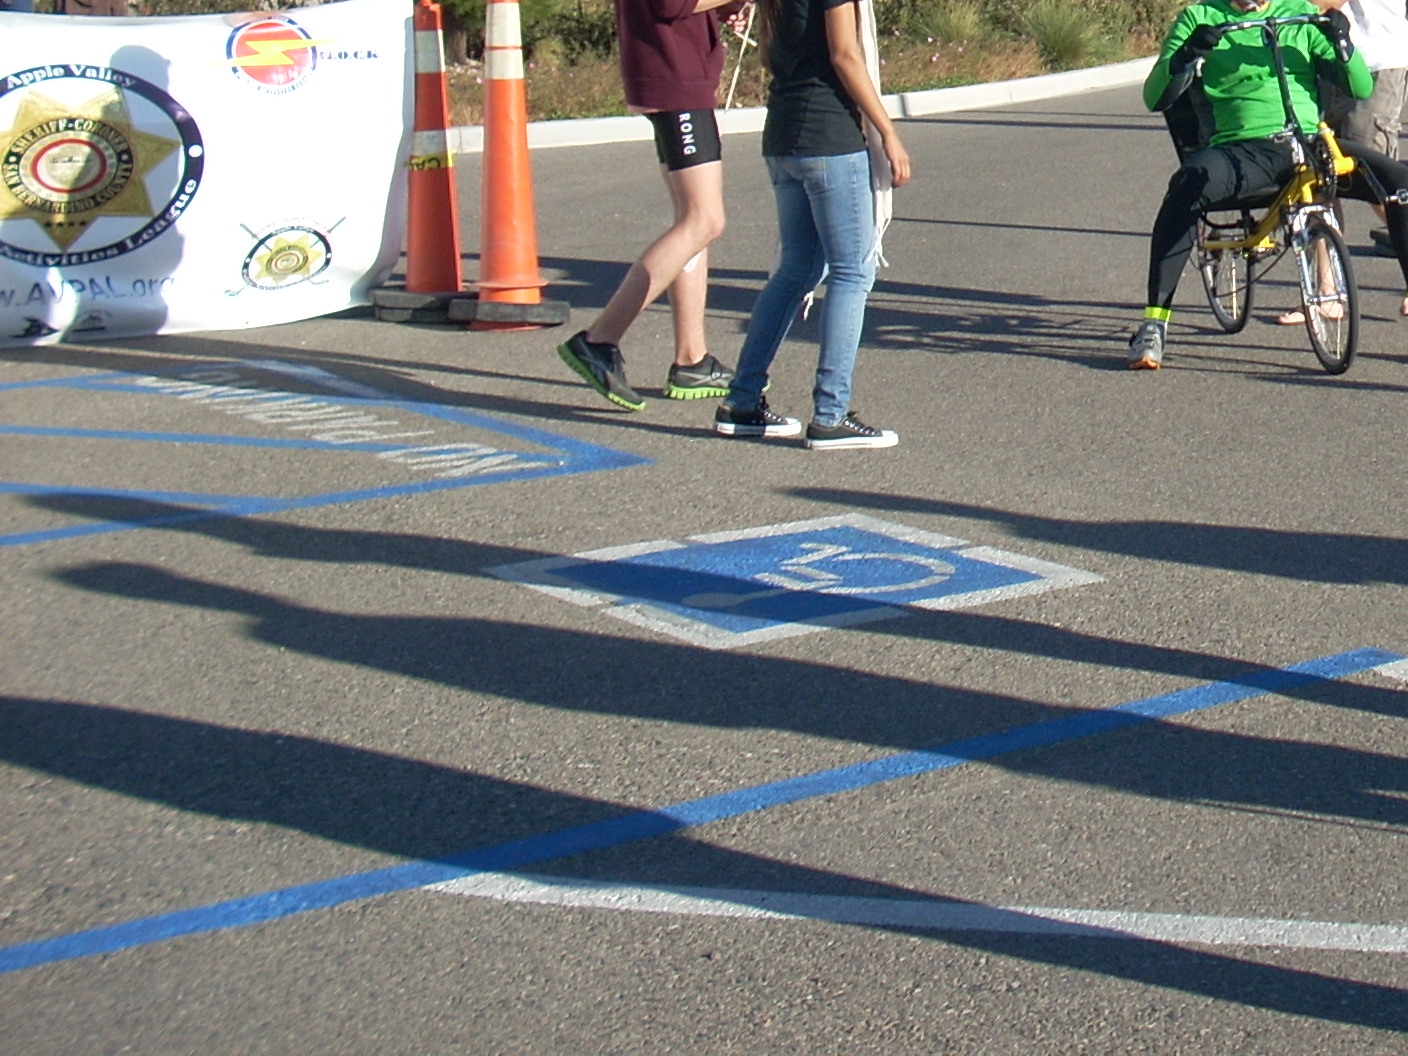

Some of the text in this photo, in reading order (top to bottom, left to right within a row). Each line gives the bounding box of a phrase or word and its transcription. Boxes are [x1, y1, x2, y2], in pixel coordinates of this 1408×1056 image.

[6, 64, 136, 89] Apple Valley
[679, 113, 697, 155] RONG
[2, 164, 21, 186] SAN
[123, 178, 197, 250] League
